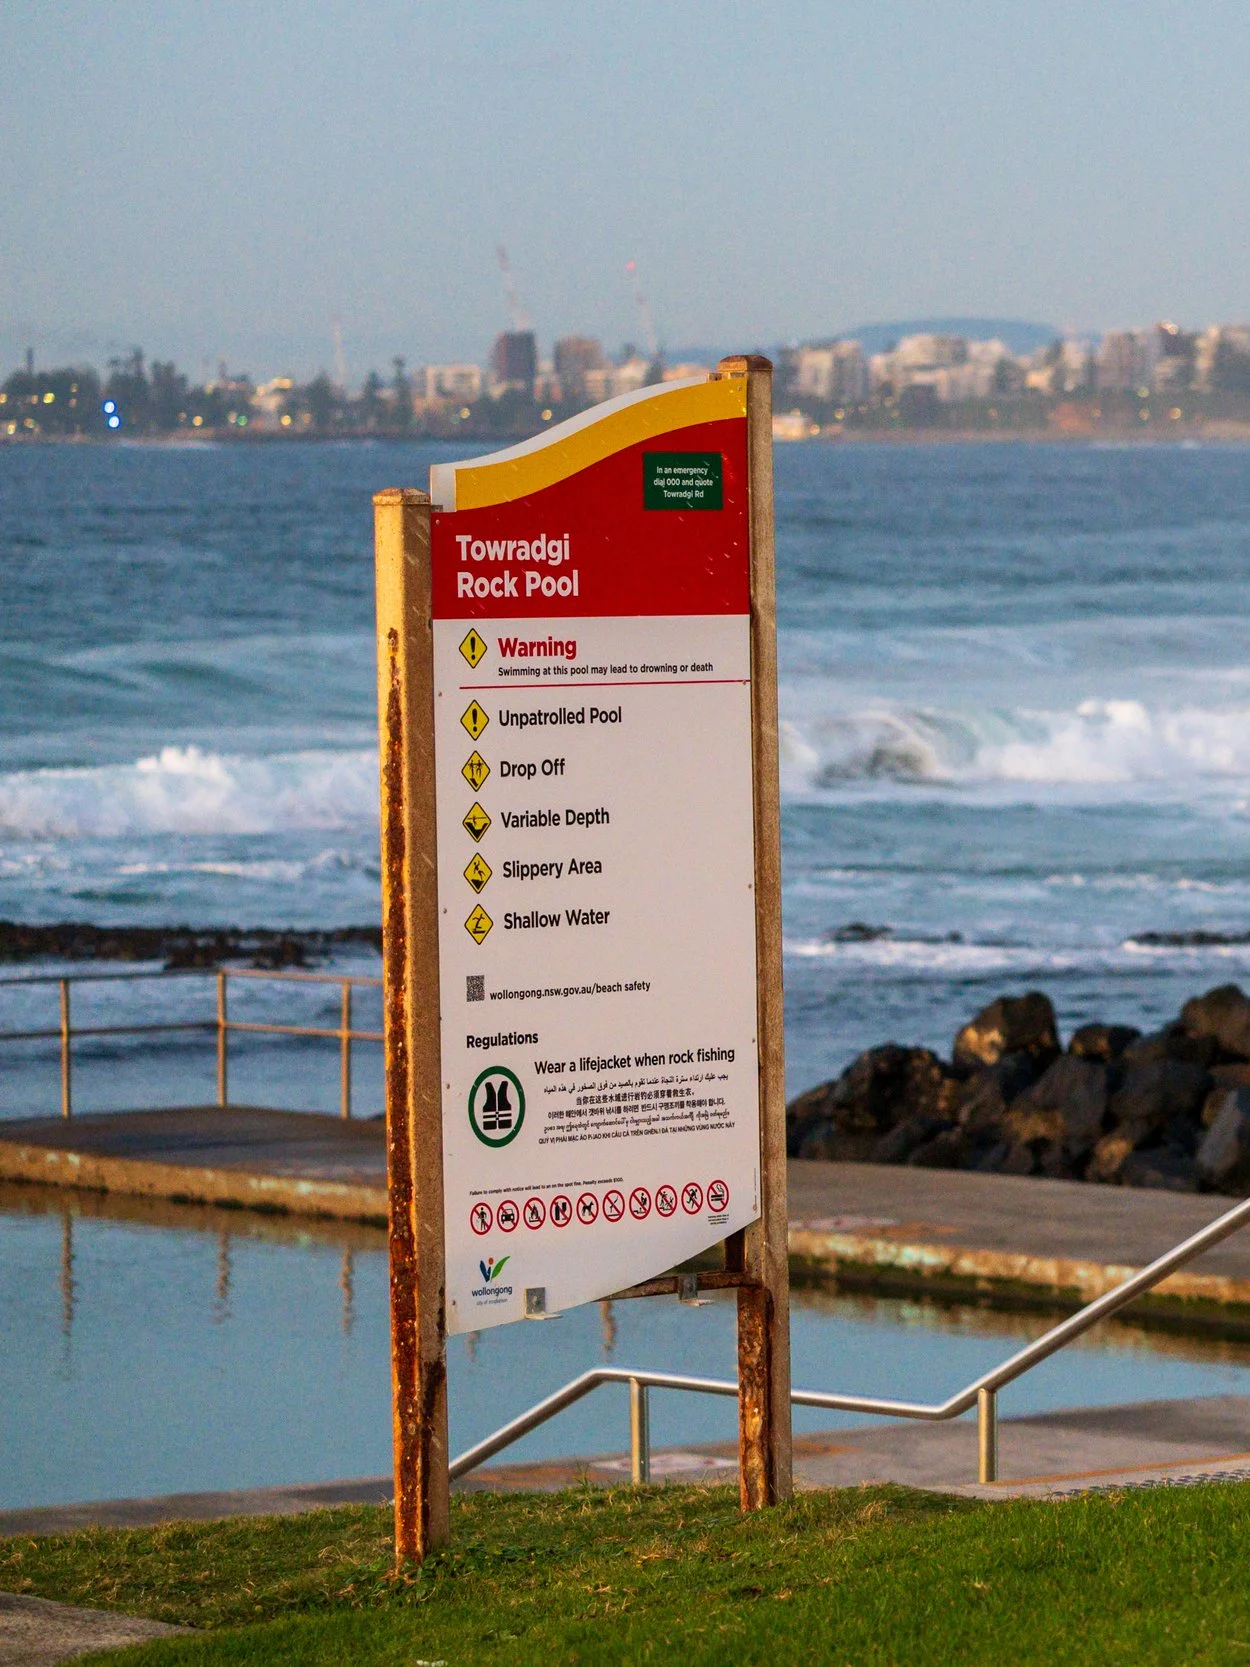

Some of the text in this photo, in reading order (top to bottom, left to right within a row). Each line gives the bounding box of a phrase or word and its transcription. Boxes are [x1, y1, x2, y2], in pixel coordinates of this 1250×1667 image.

[657, 466, 662, 474] In
[673, 467, 708, 475] emergency
[667, 478, 680, 486] 000
[682, 478, 693, 486] and
[664, 490, 704, 499] Towradgi Rd
[456, 533, 570, 566] Towradgi
[457, 569, 579, 598] Rock Pool
[498, 637, 577, 660] Warning
[498, 667, 540, 677] Swimming
[553, 665, 568, 675] this
[571, 665, 588, 676] pool
[591, 667, 607, 676] may
[610, 664, 627, 674] lead
[630, 665, 638, 673] to
[641, 664, 677, 674] drowning
[691, 662, 713, 672] death
[499, 706, 622, 729] Unpatrolled Pool
[500, 758, 565, 779] Drop Off
[501, 807, 609, 828] Variable Depth
[503, 859, 602, 880] Slippery Area
[504, 908, 610, 929] Shallow Water
[490, 980, 651, 1000] wollongong.nsw.gov.au/beach safety
[466, 1031, 538, 1049] Regulations
[535, 1047, 735, 1074] Wear a lifejacket when rock fishing
[472, 1287, 512, 1296] wollongong
